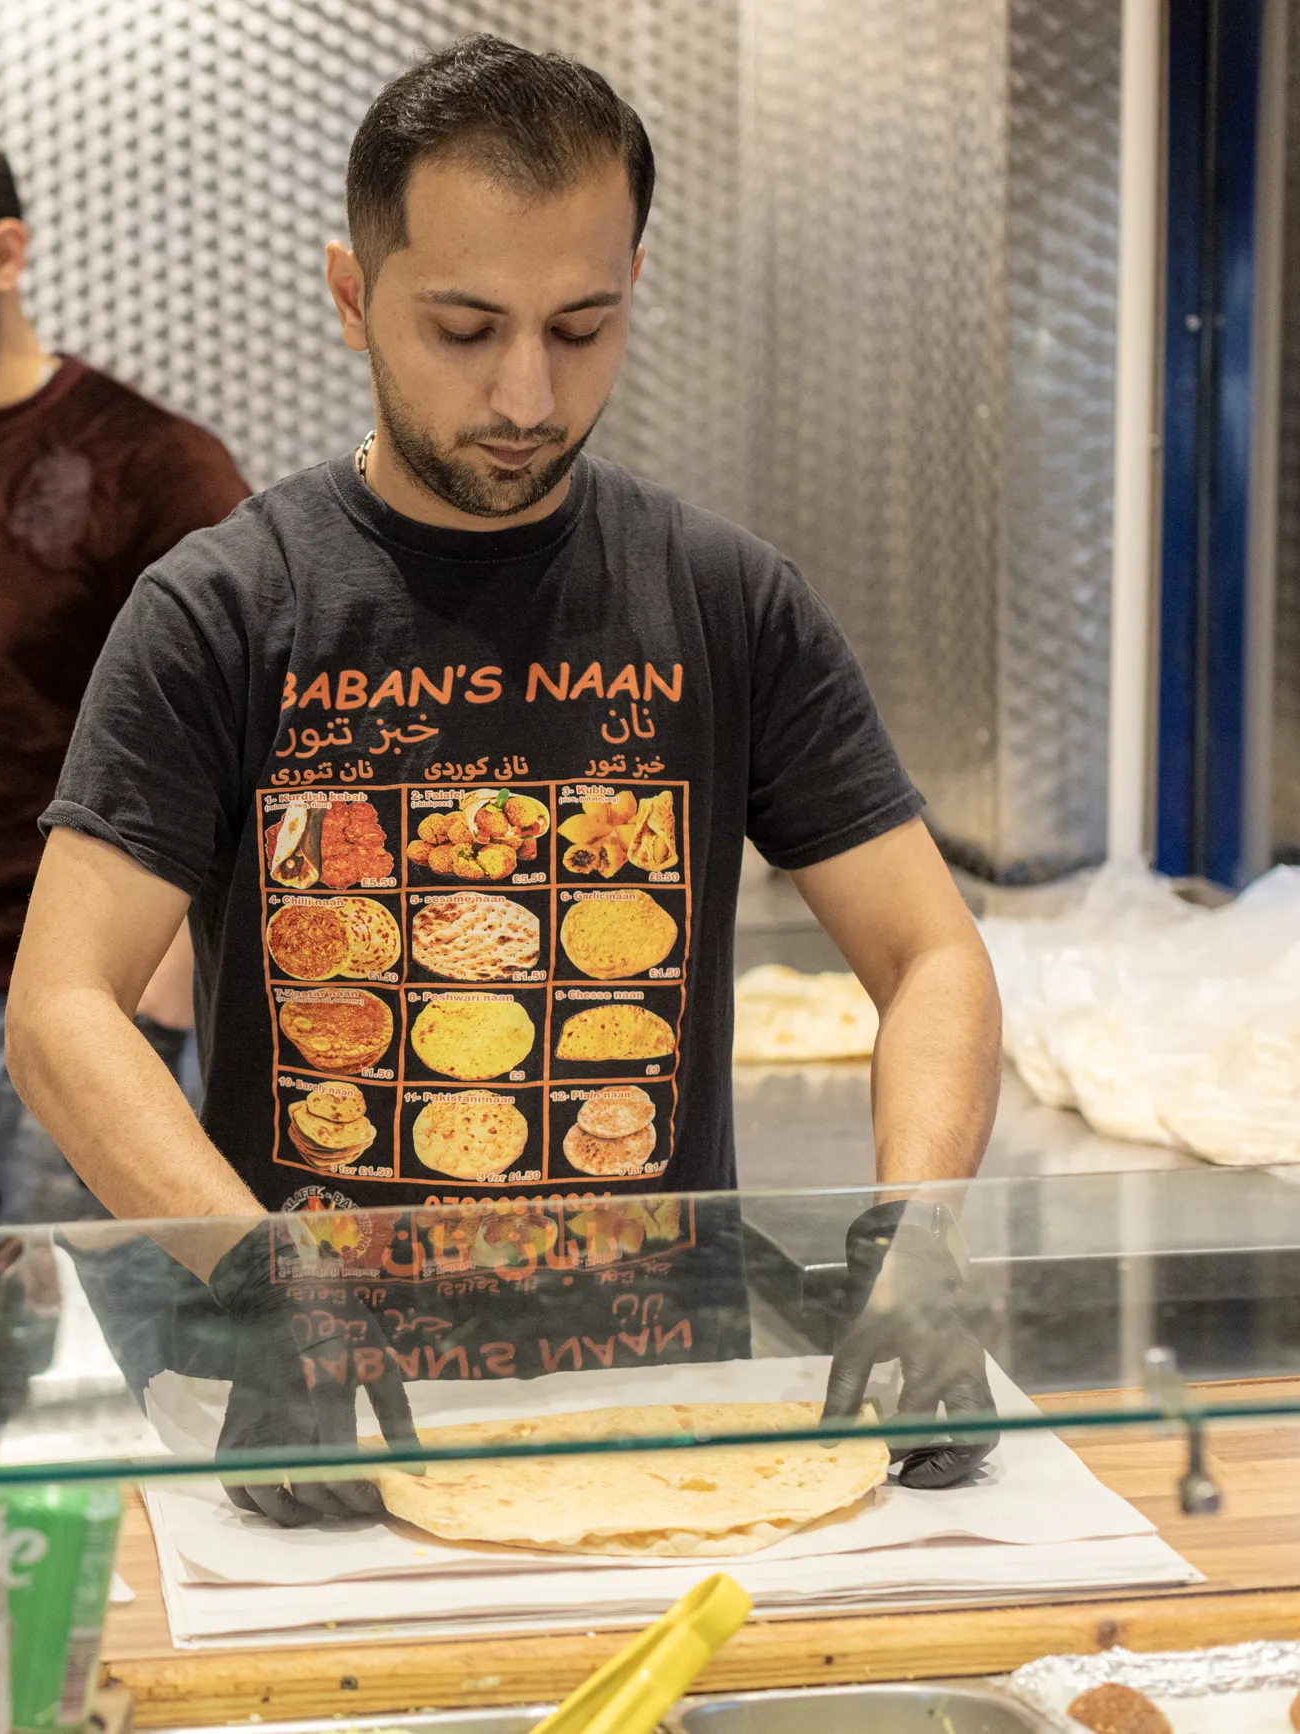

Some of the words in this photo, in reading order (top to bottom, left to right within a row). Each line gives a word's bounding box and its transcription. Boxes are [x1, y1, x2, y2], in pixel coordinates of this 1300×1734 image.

[281, 664, 503, 711] BABAN'S
[525, 662, 683, 703] NAAN
[601, 703, 655, 745] نان
[275, 717, 353, 759] تنور
[368, 714, 440, 755] خبز
[339, 760, 374, 782] نان
[584, 754, 627, 777] تنور
[632, 755, 665, 779] خبز
[411, 790, 424, 800] 2-
[425, 789, 465, 800] Falafel
[561, 785, 574, 797] 3-
[576, 785, 615, 795] Kubba
[264, 795, 278, 804] 1-
[279, 792, 327, 802] Kurdish
[329, 791, 368, 801] kebab
[411, 800, 453, 808] (chickpeas)
[361, 877, 397, 888] £5.50
[512, 872, 546, 884] £5.50
[268, 895, 281, 904] 4-
[282, 895, 313, 906] Chilli
[314, 897, 345, 906] naan
[410, 895, 423, 904] 5-
[424, 896, 473, 904] sesame
[473, 895, 506, 904] naan
[560, 891, 572, 901] 6-
[573, 891, 607, 901] Garlic
[608, 892, 636, 900] naan
[367, 972, 398, 982] £1.50
[512, 970, 547, 981] £1.50
[648, 967, 680, 978] £1.50
[408, 991, 421, 1002] 8-
[422, 991, 480, 1002] Peshwari
[482, 993, 514, 1002] naan
[568, 990, 612, 1000] Chesse
[613, 990, 645, 1000] naan
[361, 1067, 394, 1079] £1.50
[646, 1063, 660, 1075] £3
[509, 1070, 525, 1081] £3
[278, 1076, 295, 1087] 10-
[295, 1079, 327, 1094] Barely
[328, 1087, 355, 1097] naan
[404, 1092, 421, 1103] 11-
[423, 1092, 482, 1103] Pakistani
[483, 1094, 515, 1104] naan
[550, 1091, 569, 1102] 12-
[570, 1090, 600, 1100] Plain
[603, 1090, 632, 1098] naan
[330, 1163, 337, 1173] 3
[339, 1164, 357, 1175] for
[358, 1166, 393, 1178] £1.50
[476, 1172, 484, 1182] 3
[487, 1172, 507, 1182] for
[508, 1170, 541, 1182] £1.50
[627, 1165, 644, 1175] for
